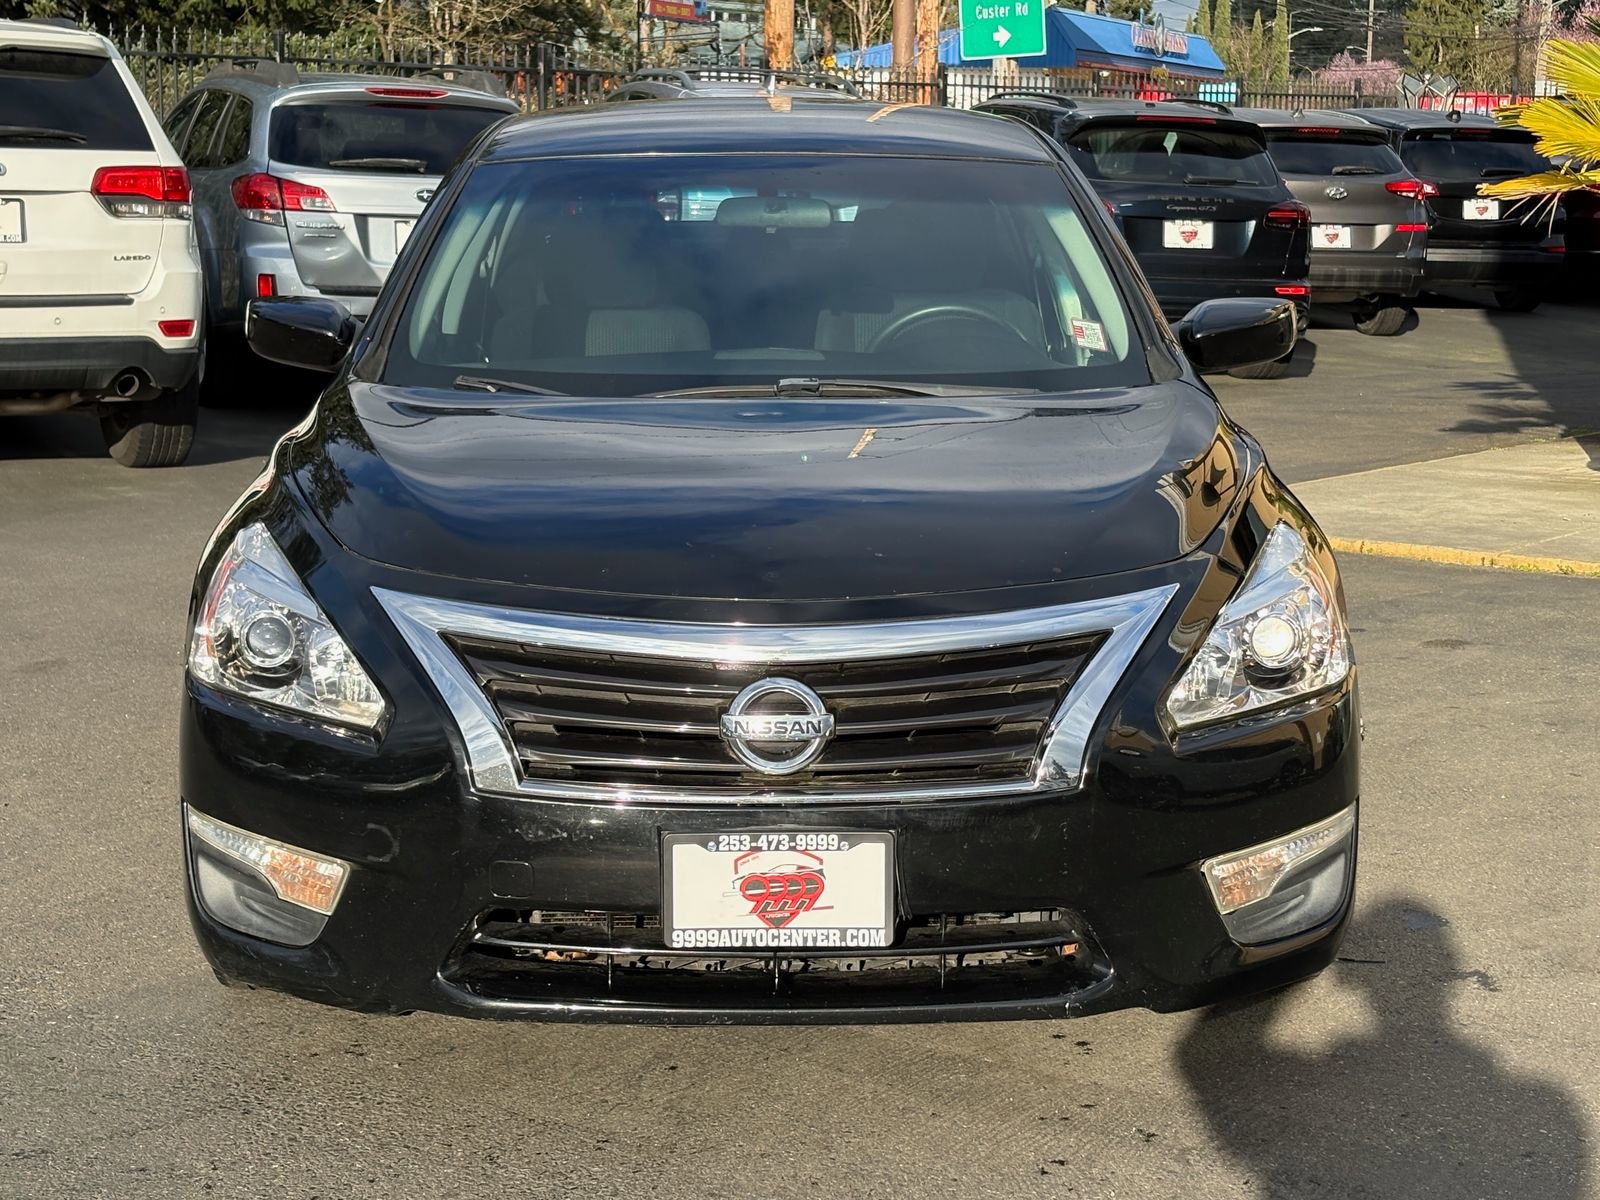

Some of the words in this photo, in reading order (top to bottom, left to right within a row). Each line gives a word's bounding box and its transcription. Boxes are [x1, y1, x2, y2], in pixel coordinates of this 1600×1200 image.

[1015, 2, 1029, 17] Rd
[113, 254, 152, 262] LAREDO
[734, 720, 822, 735] NSSAN
[718, 834, 839, 851] 253-473-9999
[671, 928, 886, 948] 9999AUTOCENTER.COM
